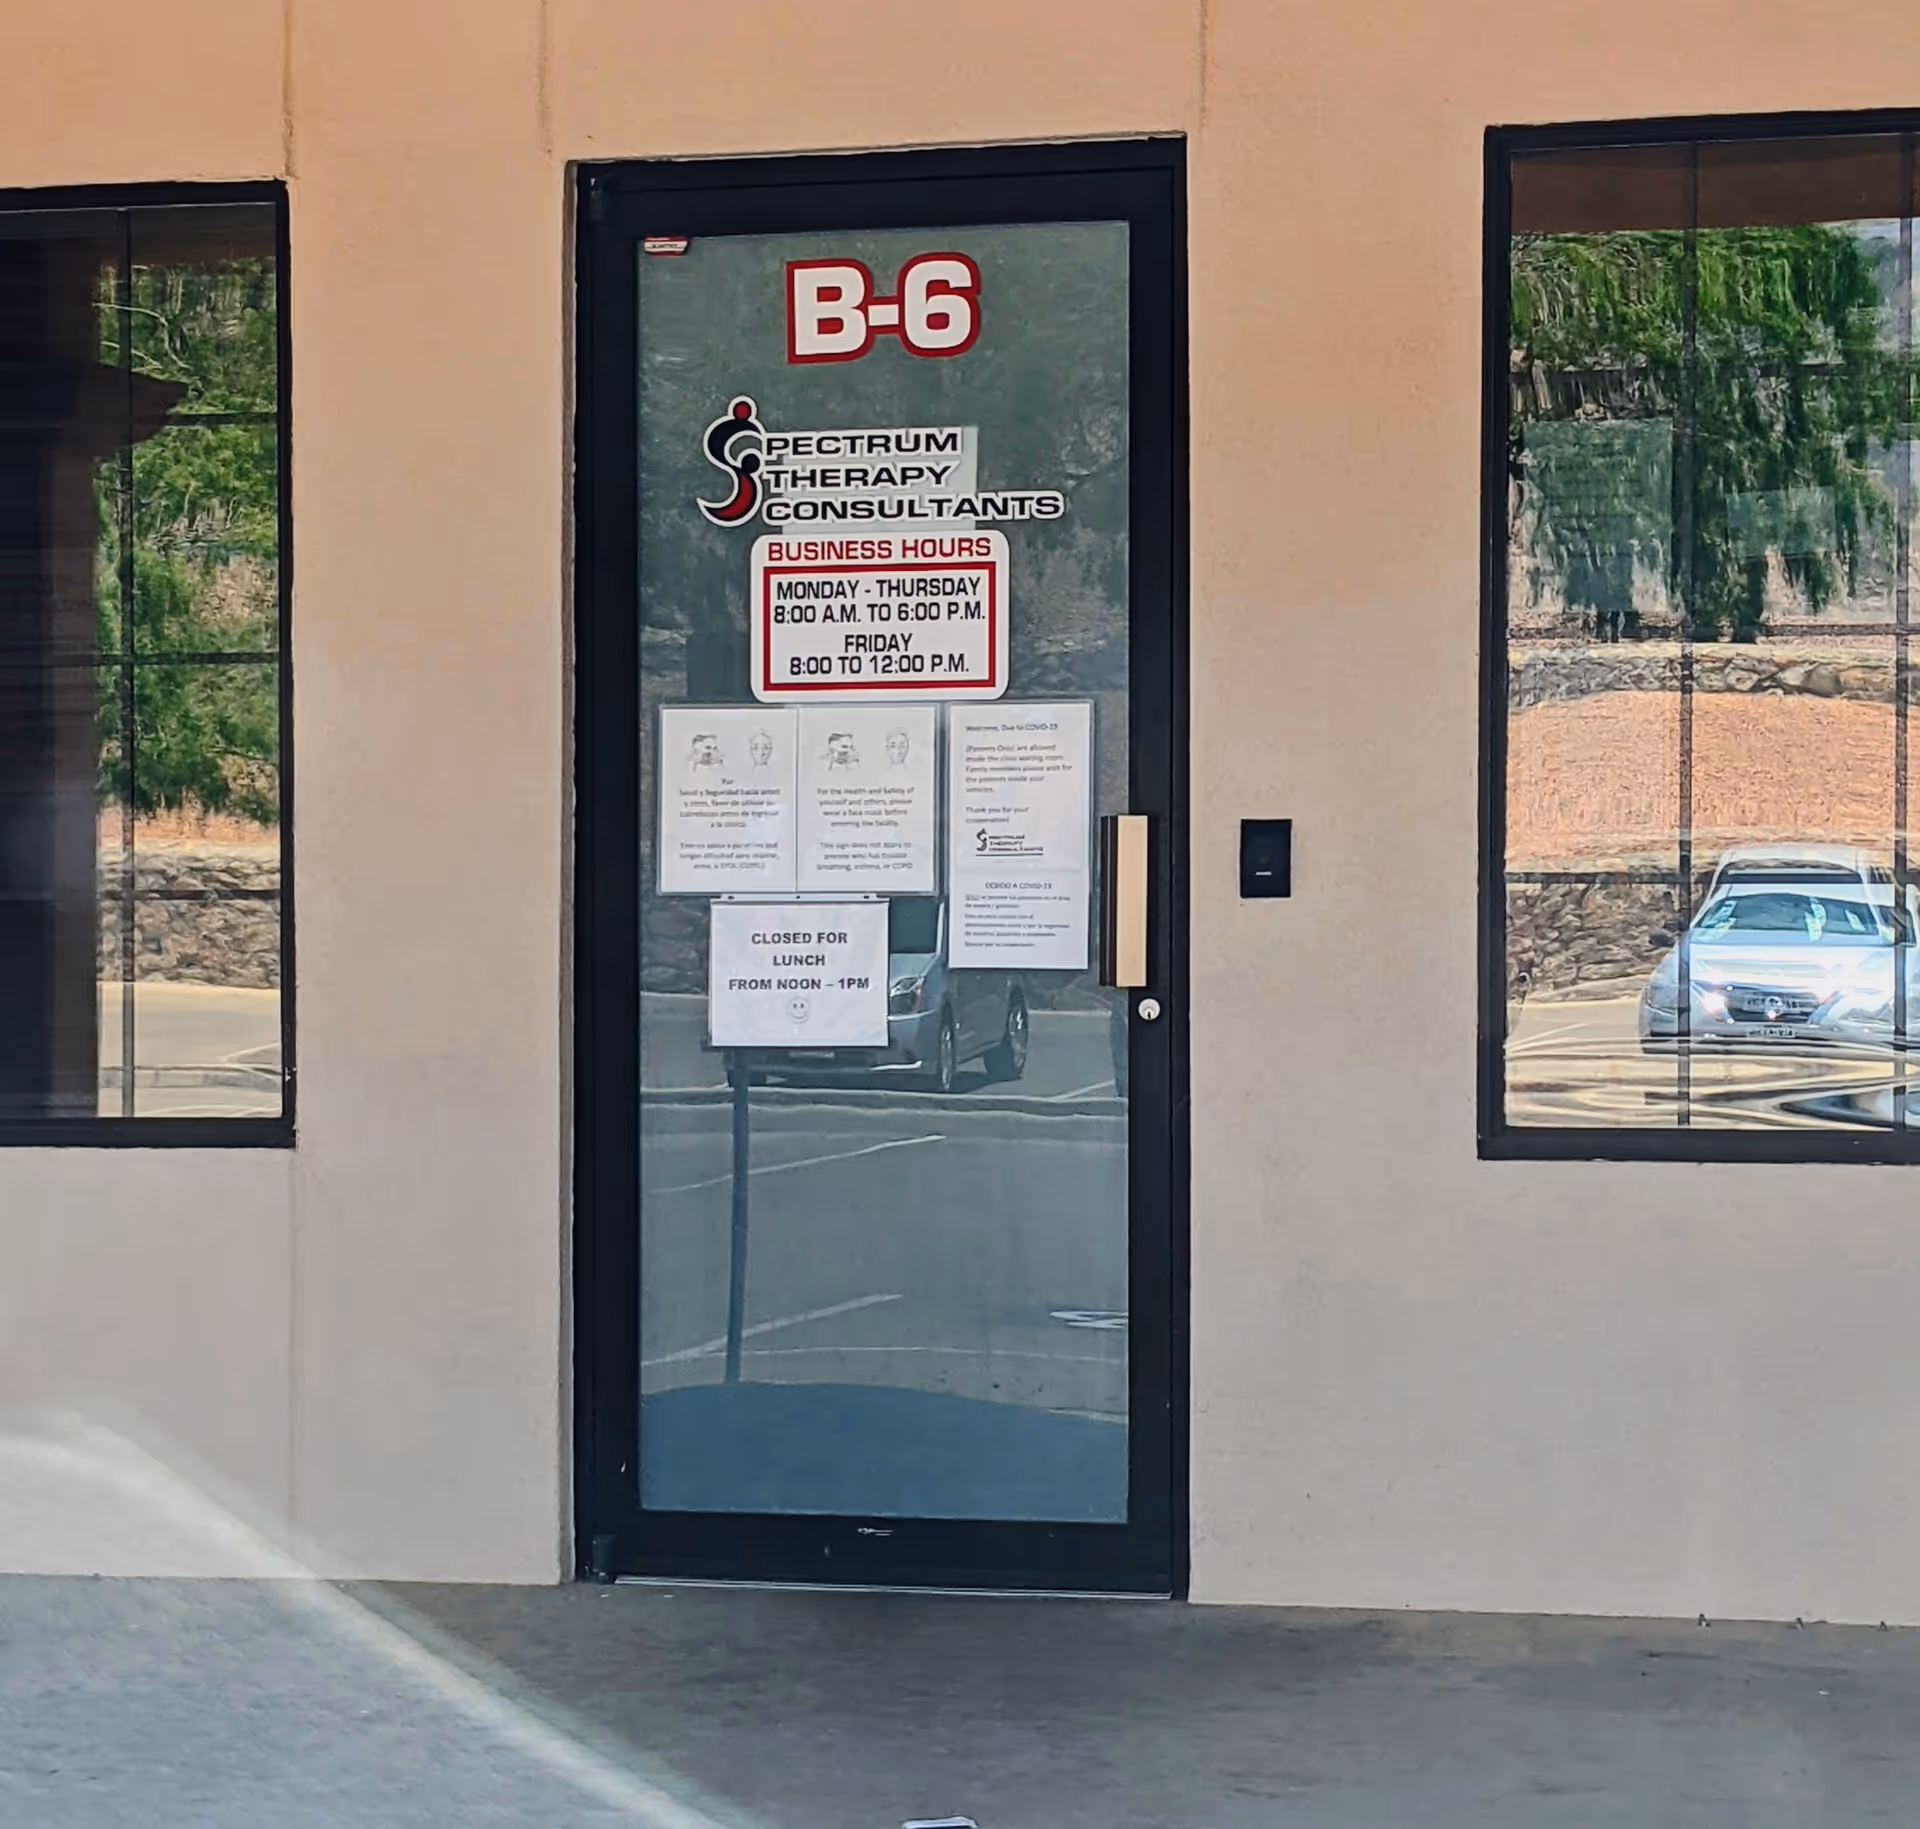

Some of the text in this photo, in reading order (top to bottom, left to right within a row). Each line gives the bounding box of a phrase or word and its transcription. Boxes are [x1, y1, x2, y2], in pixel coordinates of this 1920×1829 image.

[789, 255, 978, 361] B-6
[768, 464, 953, 489] THERAPY
[765, 494, 1061, 521] CONSULTANTS
[768, 537, 991, 562] BUSINESS HOURS
[776, 579, 860, 600] MONDAY
[875, 577, 981, 598] THURSDAY
[774, 600, 986, 624] 8:00 A.M. TO 6:00 P.M.
[844, 633, 913, 653] FRIDAY
[789, 653, 970, 676] 8:00 TO 12:00 P.M.
[751, 932, 848, 945] CLOSED FOR
[772, 954, 826, 966] LUNCH
[728, 978, 772, 990] FROM
[777, 978, 822, 990] NOON
[838, 977, 870, 989] 1PM
